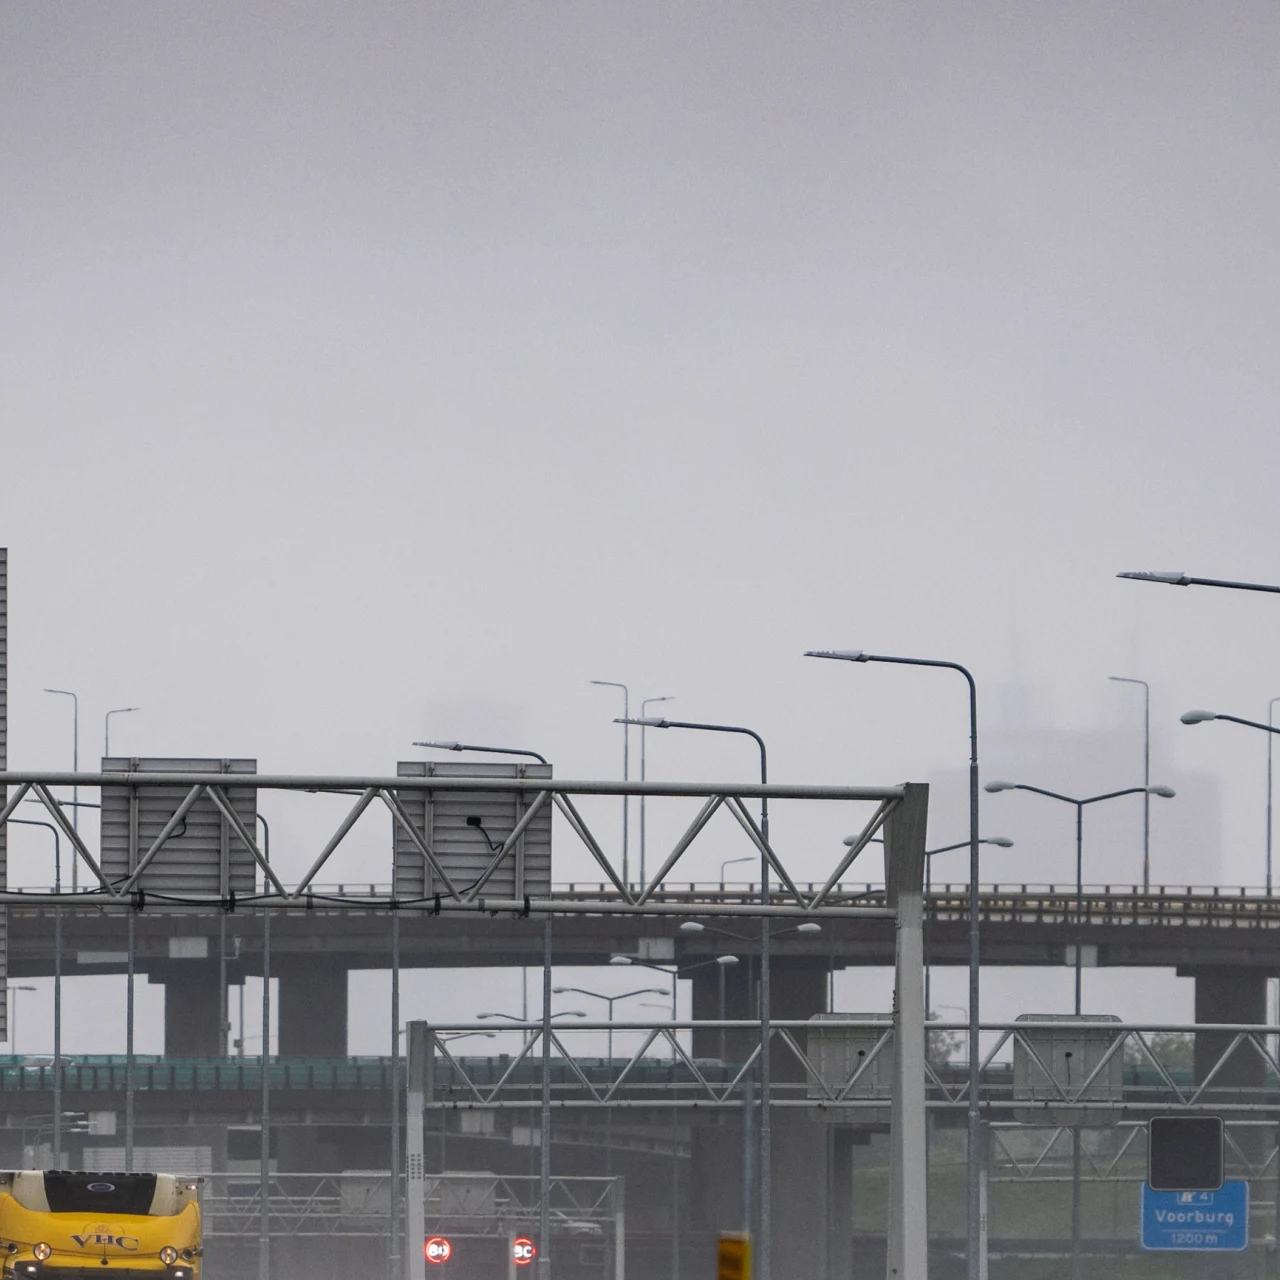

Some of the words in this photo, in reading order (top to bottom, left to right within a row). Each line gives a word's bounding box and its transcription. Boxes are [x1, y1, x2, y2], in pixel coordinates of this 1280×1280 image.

[1155, 1209, 1234, 1227] Voorburg
[69, 1234, 139, 1251] VHC
[1171, 1233, 1203, 1243] 1200
[1205, 1234, 1218, 1243] m
